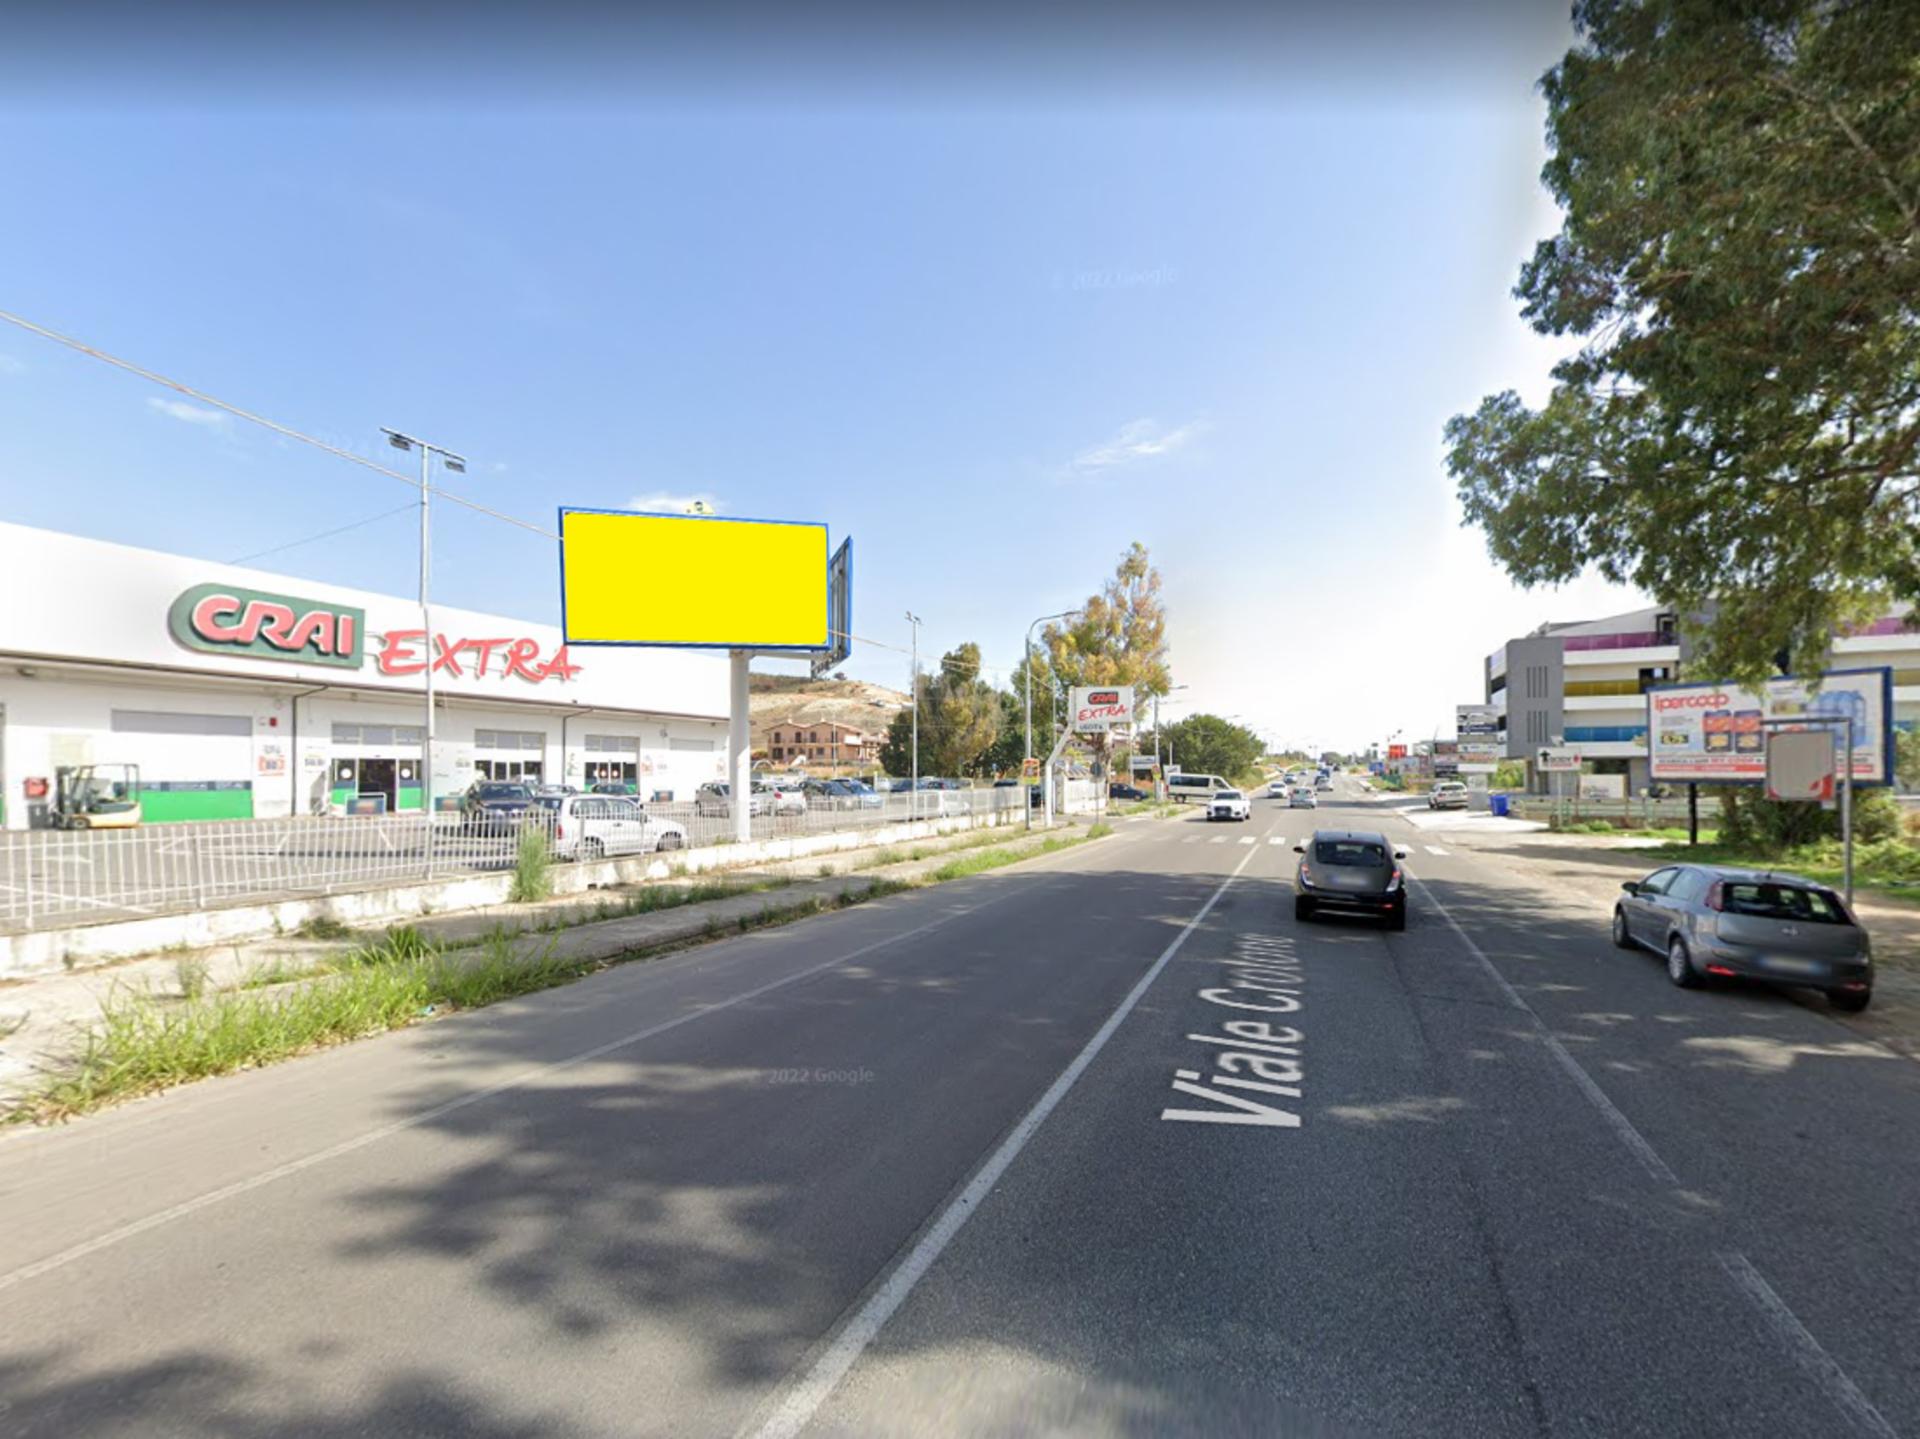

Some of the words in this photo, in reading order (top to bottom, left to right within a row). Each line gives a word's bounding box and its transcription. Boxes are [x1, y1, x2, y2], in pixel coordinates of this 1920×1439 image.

[191, 594, 355, 657] CRAI
[377, 629, 584, 682] EXTRA
[1078, 703, 1128, 721] EXTRA
[1655, 694, 1729, 713] ipercoop
